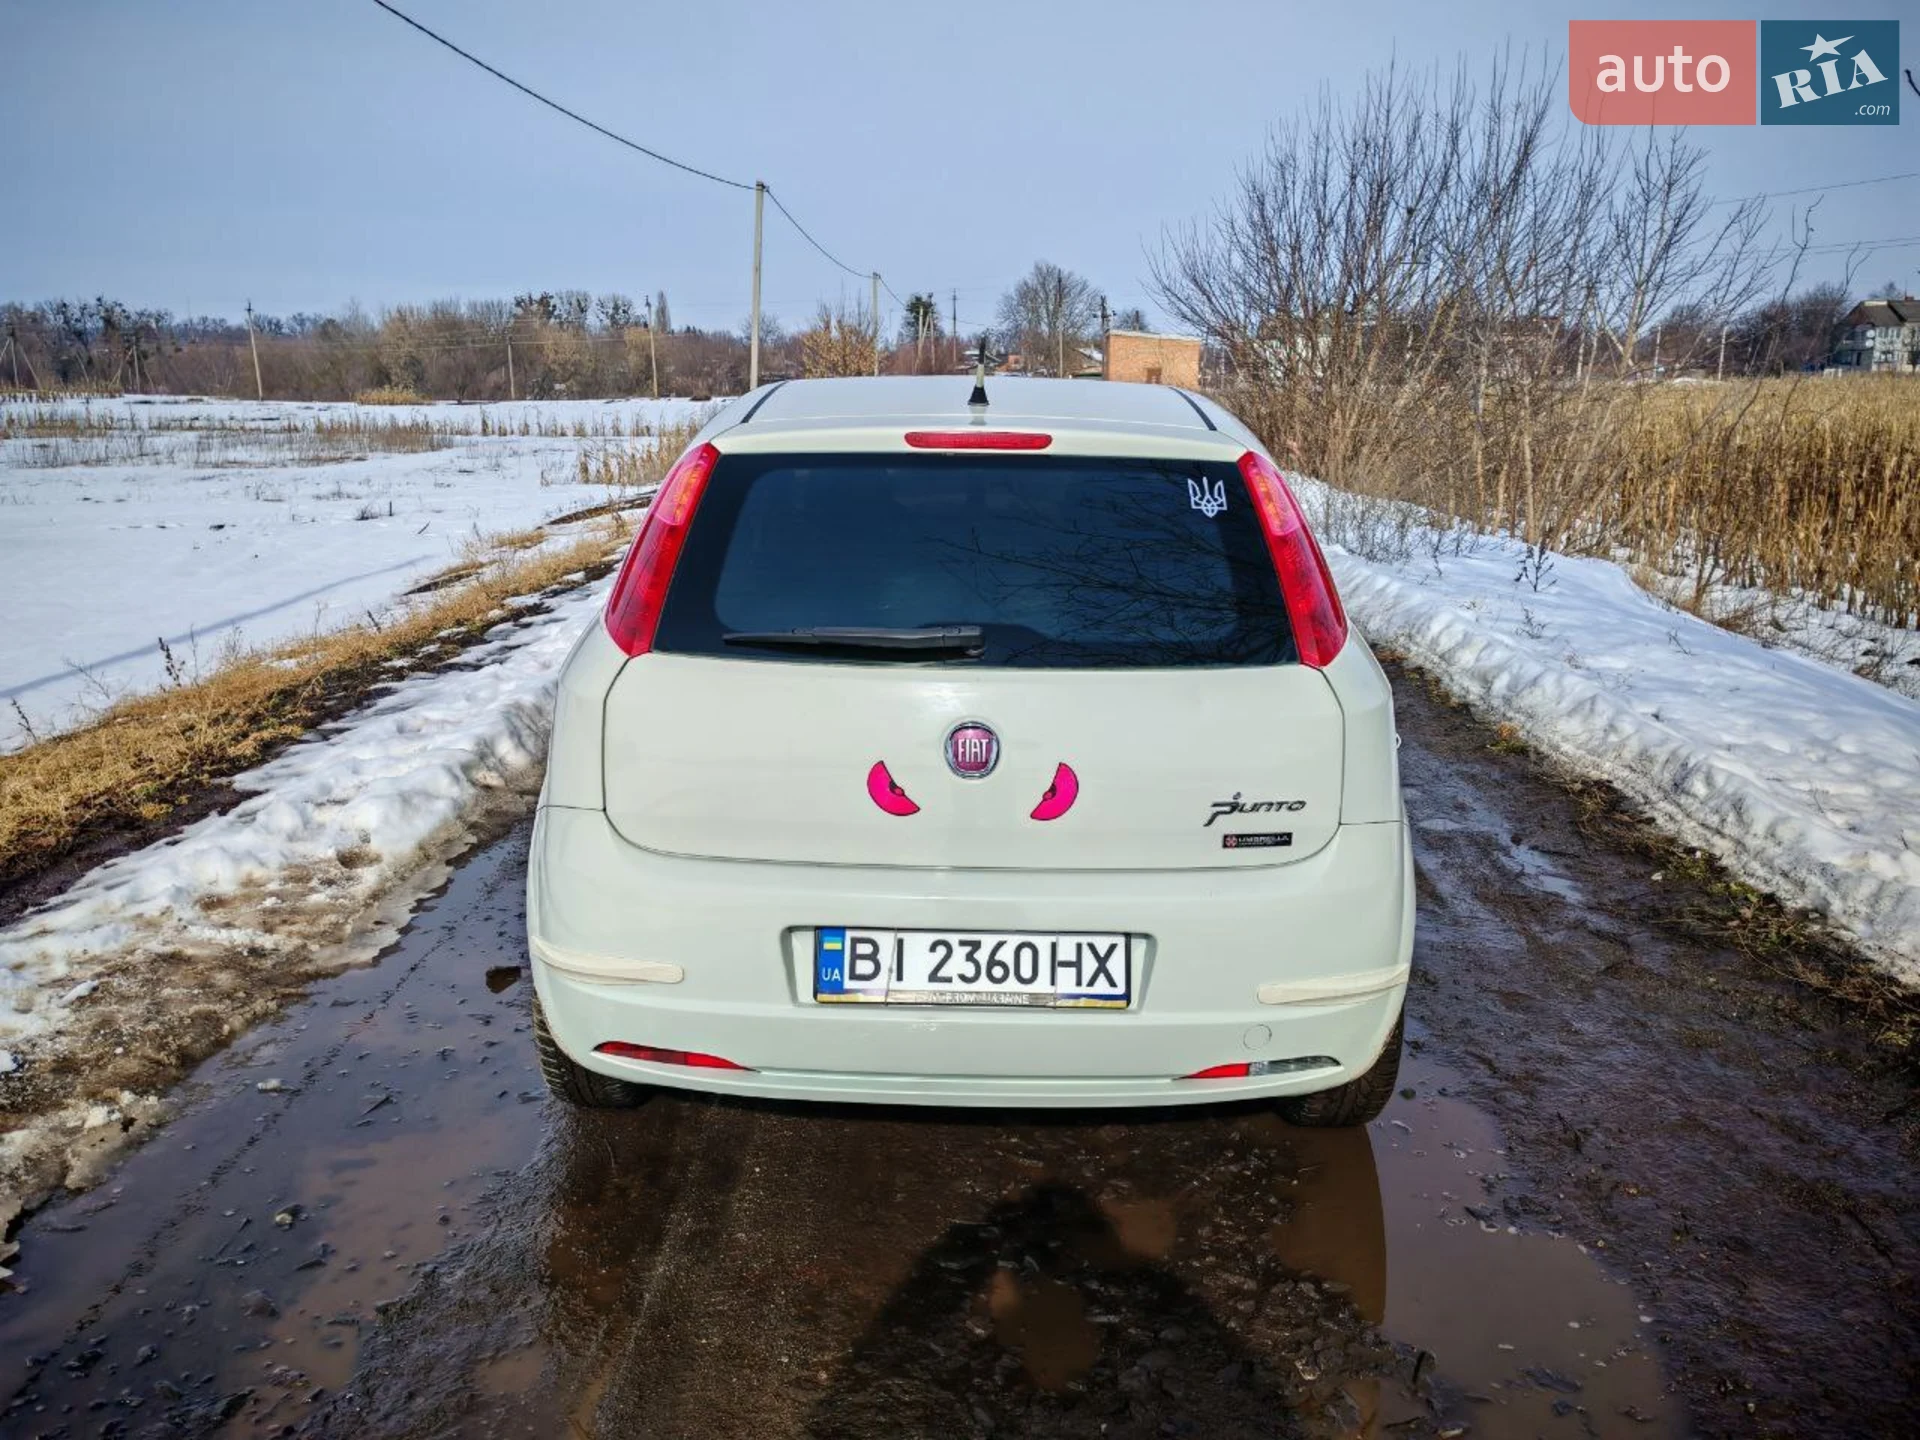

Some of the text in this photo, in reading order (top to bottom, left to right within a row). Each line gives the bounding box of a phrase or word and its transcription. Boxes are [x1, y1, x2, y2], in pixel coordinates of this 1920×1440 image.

[958, 739, 989, 763] FIAT
[849, 937, 1118, 987] BI 2360 HX
[822, 969, 841, 981] UA
